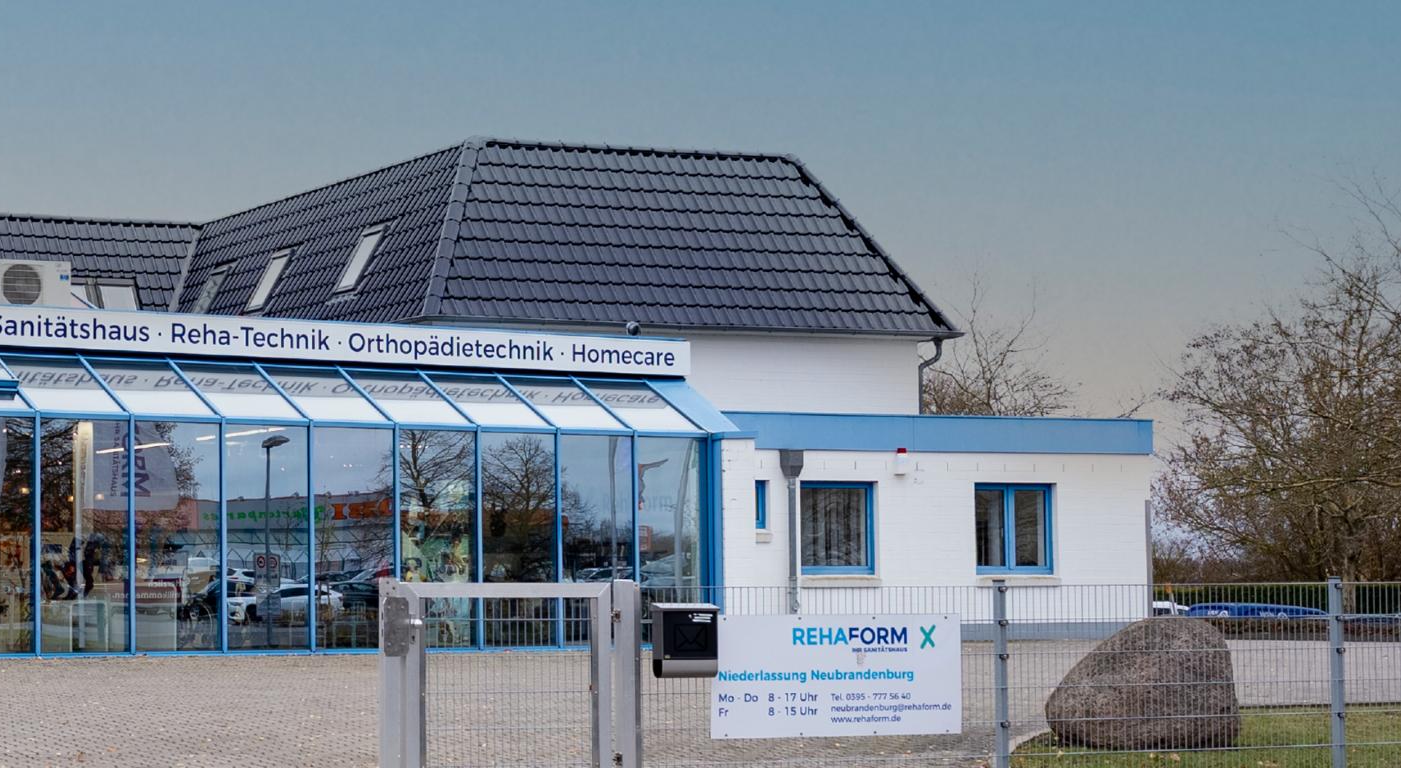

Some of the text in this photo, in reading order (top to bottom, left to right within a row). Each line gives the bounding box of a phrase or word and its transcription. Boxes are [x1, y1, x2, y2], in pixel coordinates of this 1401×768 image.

[171, 322, 331, 351] Reha-Technik
[349, 332, 554, 361] Orthopädietechnik
[572, 343, 675, 366] Homecare
[792, 626, 908, 646] REHAFORM
[718, 668, 914, 683] Niederlassung Neubrandenburg
[718, 693, 735, 703] Mo
[744, 692, 759, 702] Do
[768, 693, 775, 702] 8
[785, 692, 797, 702] 17
[800, 692, 818, 702] Uhr
[845, 692, 866, 701] 0395
[872, 692, 888, 700] 777
[889, 692, 900, 700] 56
[901, 692, 912, 700] 40
[718, 707, 729, 717] Fr
[768, 707, 775, 717] 8
[785, 706, 797, 716] 15
[800, 706, 818, 716] Uhr
[830, 702, 952, 713] neubrandenburg@rehaform.de
[830, 714, 902, 724] www.rehaform.de
